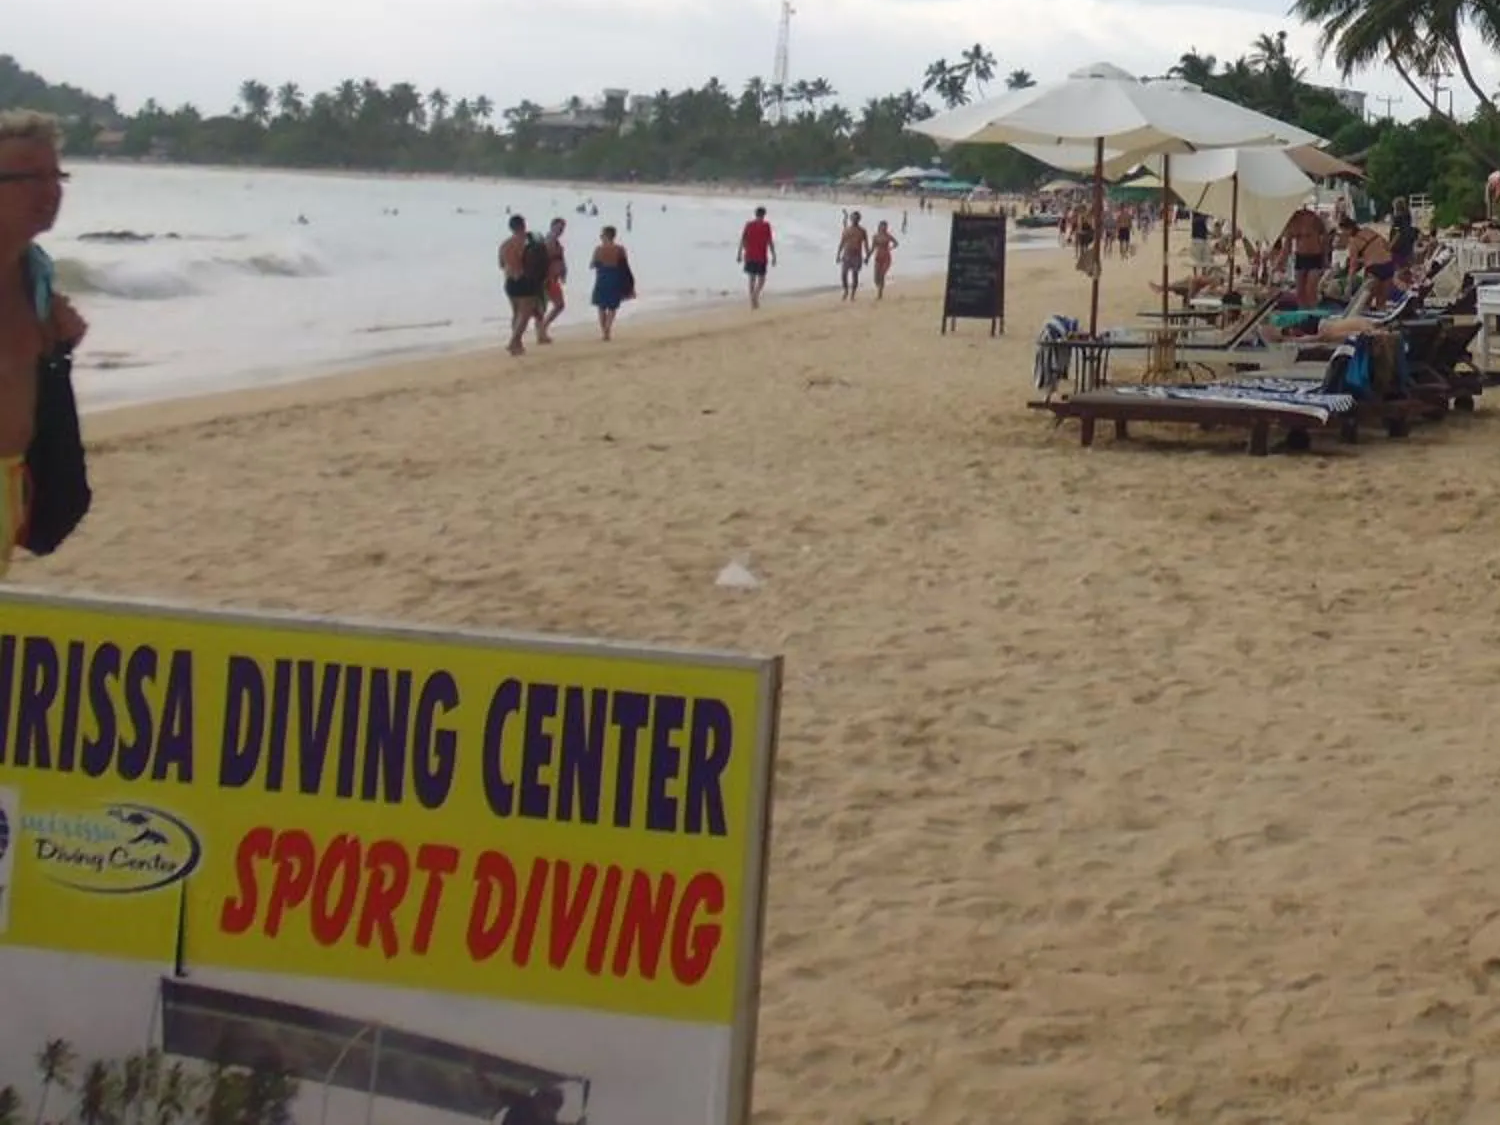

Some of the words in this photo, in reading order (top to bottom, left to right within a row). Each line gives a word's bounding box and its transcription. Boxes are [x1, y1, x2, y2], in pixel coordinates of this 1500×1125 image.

[218, 655, 460, 810] DIVING
[482, 678, 733, 837] CENTER
[35, 837, 105, 873] Diving
[109, 845, 177, 872] Center
[220, 826, 460, 959] SPORT
[465, 849, 725, 986] DIVING
